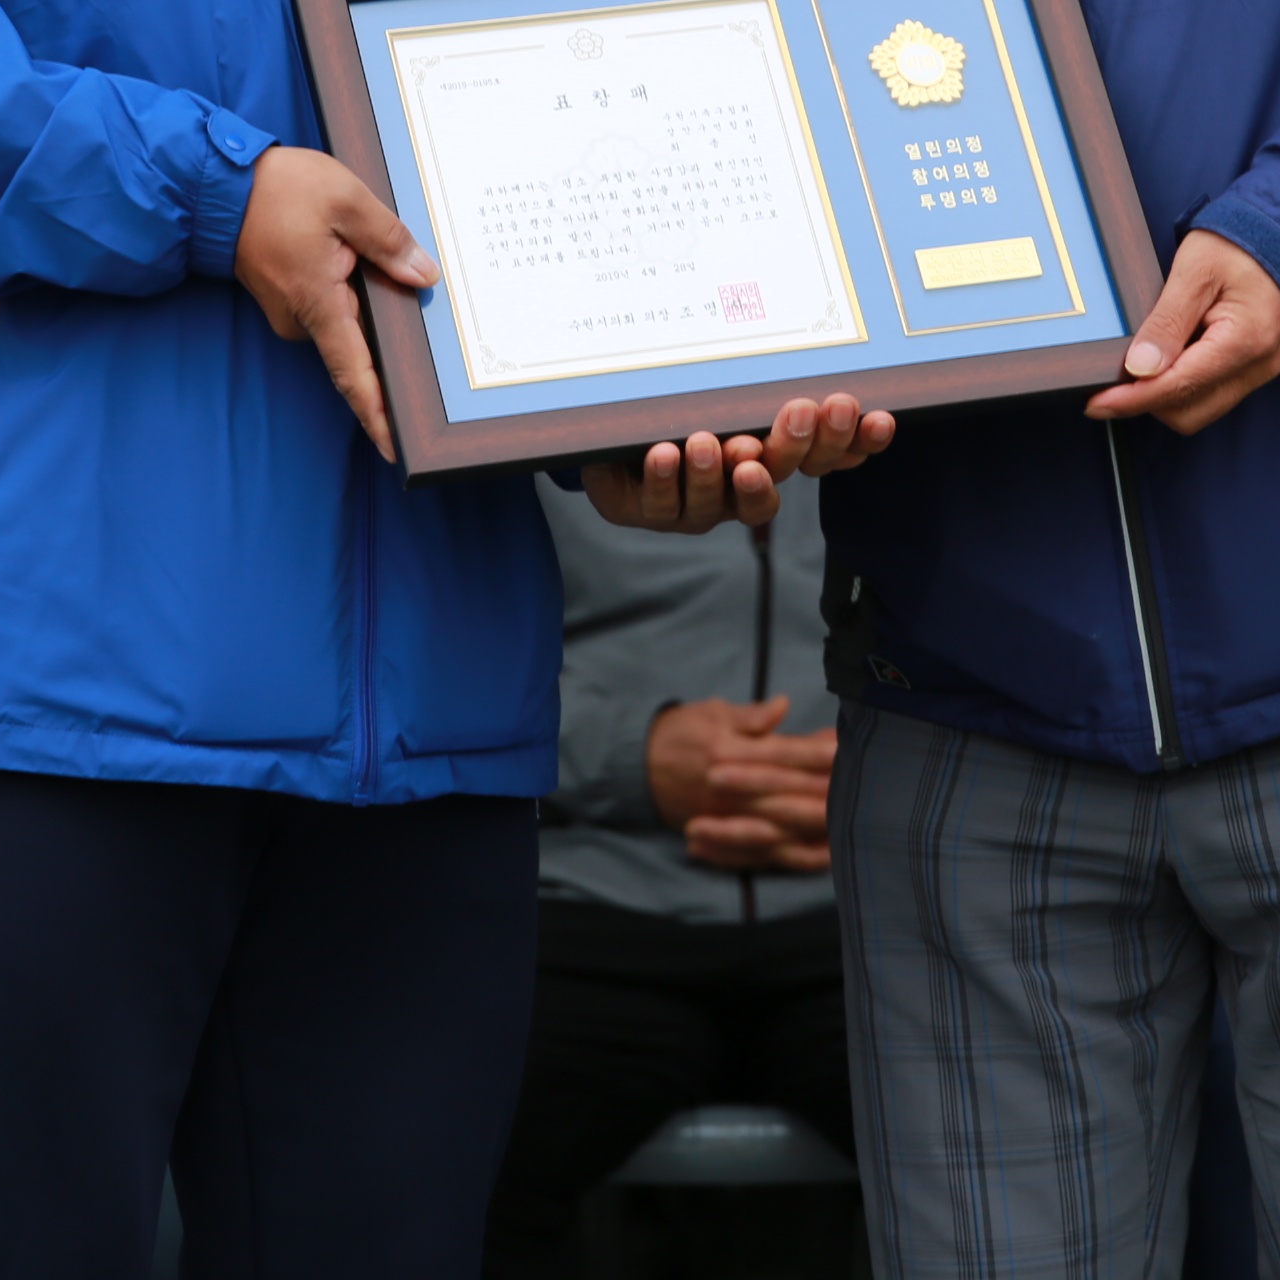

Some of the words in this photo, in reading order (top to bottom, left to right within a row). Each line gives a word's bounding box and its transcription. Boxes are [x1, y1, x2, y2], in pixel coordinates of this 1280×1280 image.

[904, 135, 983, 161] 열린의정
[912, 160, 991, 186] 참여의정
[920, 185, 999, 211] 투명의정
[486, 235, 552, 252] 수원시의회
[925, 243, 1030, 272] 수원시의회
[570, 312, 634, 331] 수원시의회
[645, 308, 669, 322] 의장
